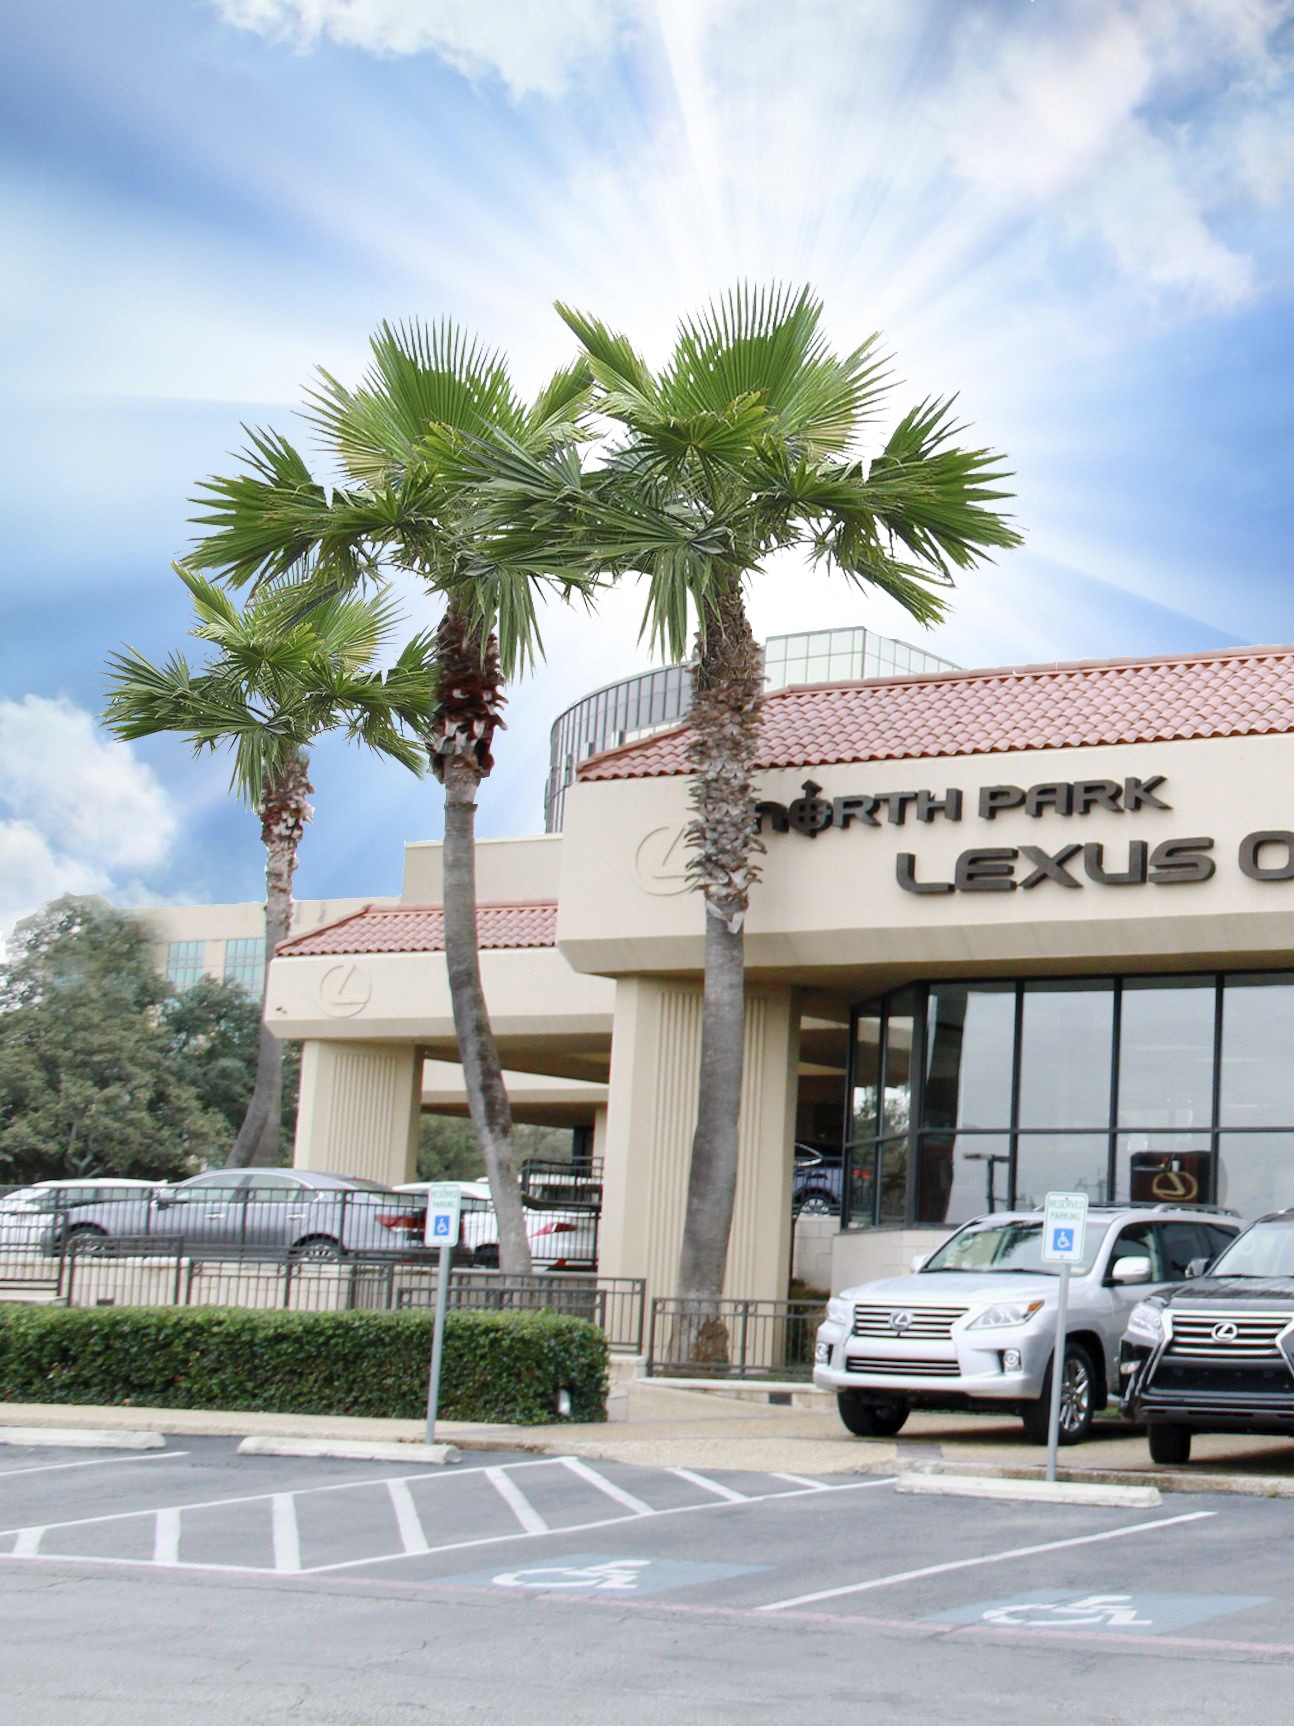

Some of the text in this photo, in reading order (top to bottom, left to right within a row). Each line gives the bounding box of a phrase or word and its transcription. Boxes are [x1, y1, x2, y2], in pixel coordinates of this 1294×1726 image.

[752, 775, 1173, 838] NORTH PARK
[896, 836, 1216, 894] LEXUS
[1050, 1211, 1081, 1221] PARKING
